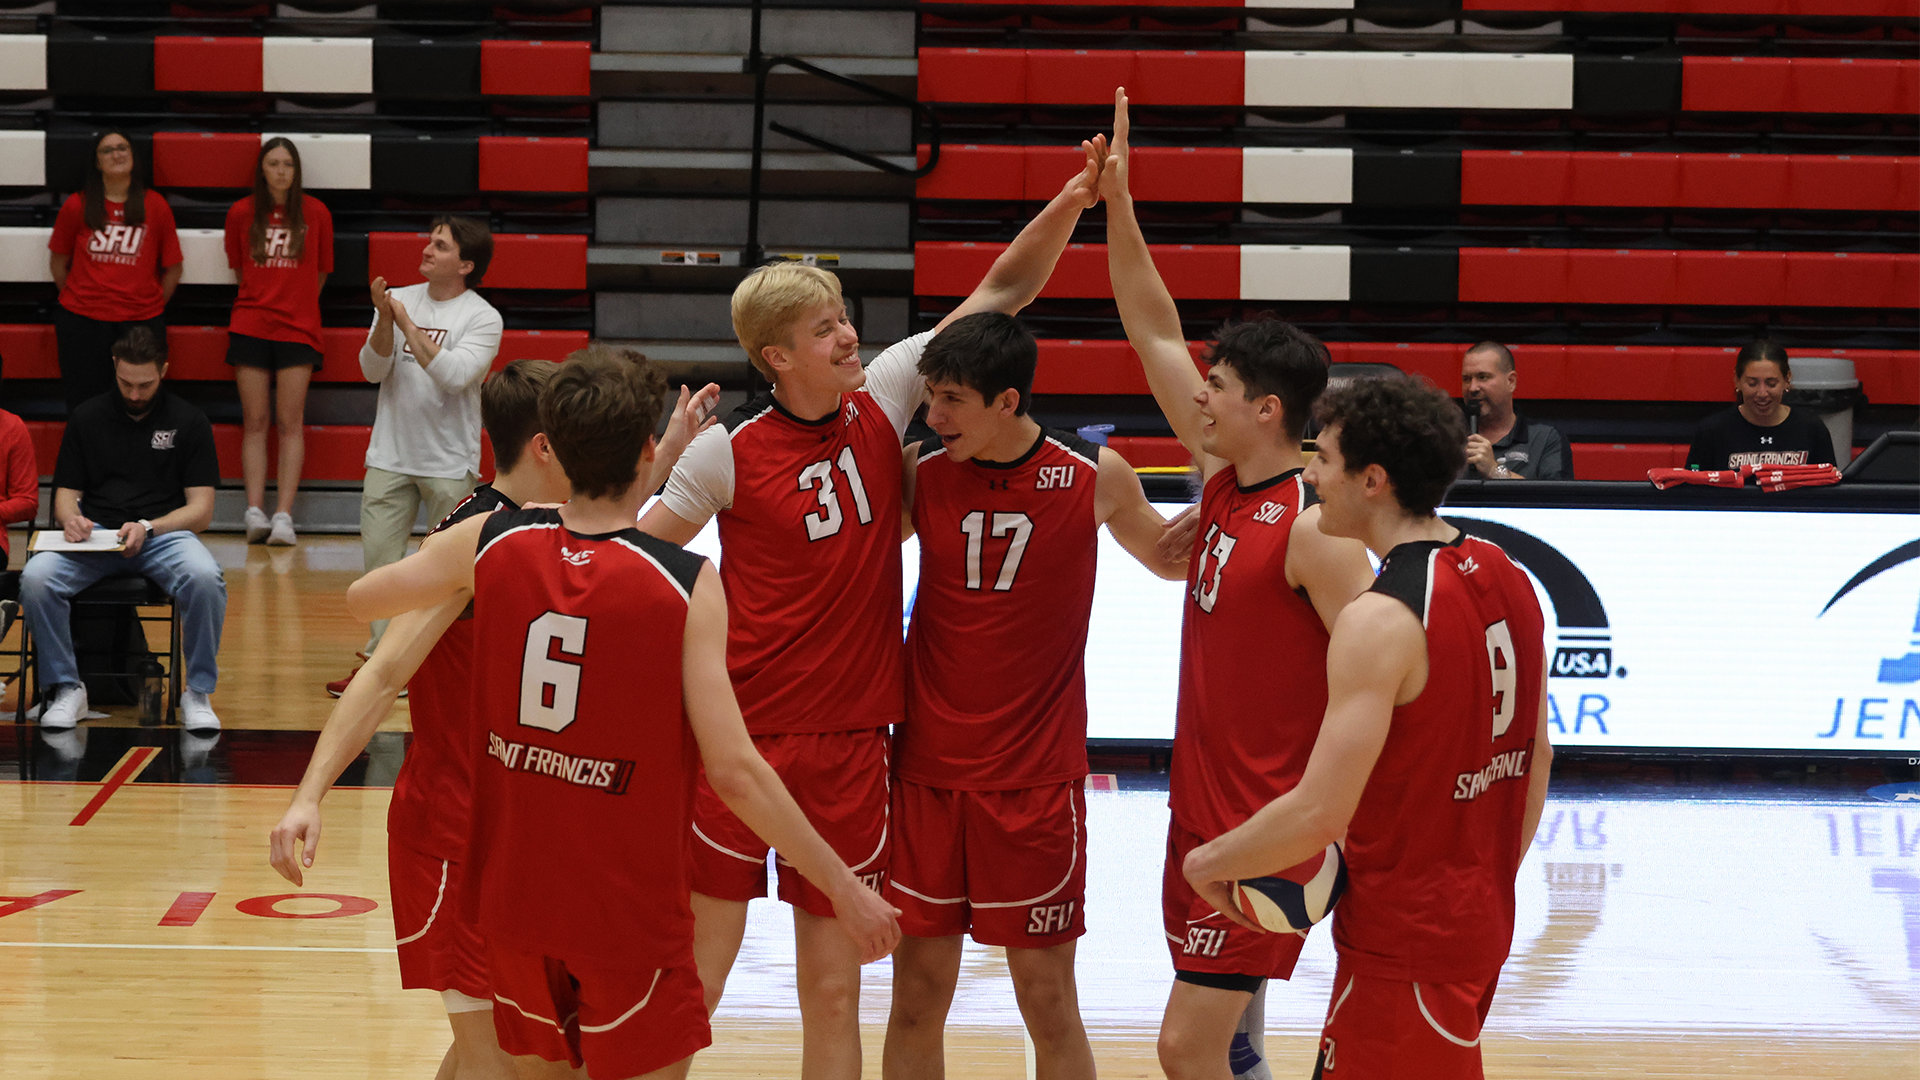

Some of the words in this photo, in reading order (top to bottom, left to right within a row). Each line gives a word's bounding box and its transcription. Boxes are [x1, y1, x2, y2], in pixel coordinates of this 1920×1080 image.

[90, 224, 143, 254] SFU
[797, 444, 874, 542] 31
[1036, 465, 1075, 489] SFU
[960, 509, 1035, 592] 17
[1191, 521, 1238, 614] 13
[518, 610, 589, 734] 6
[1485, 618, 1517, 744] 9
[1556, 652, 1609, 675] USA
[523, 746, 617, 788] FRANCIS
[1028, 901, 1075, 933] SFU
[1182, 927, 1228, 957] SFU
